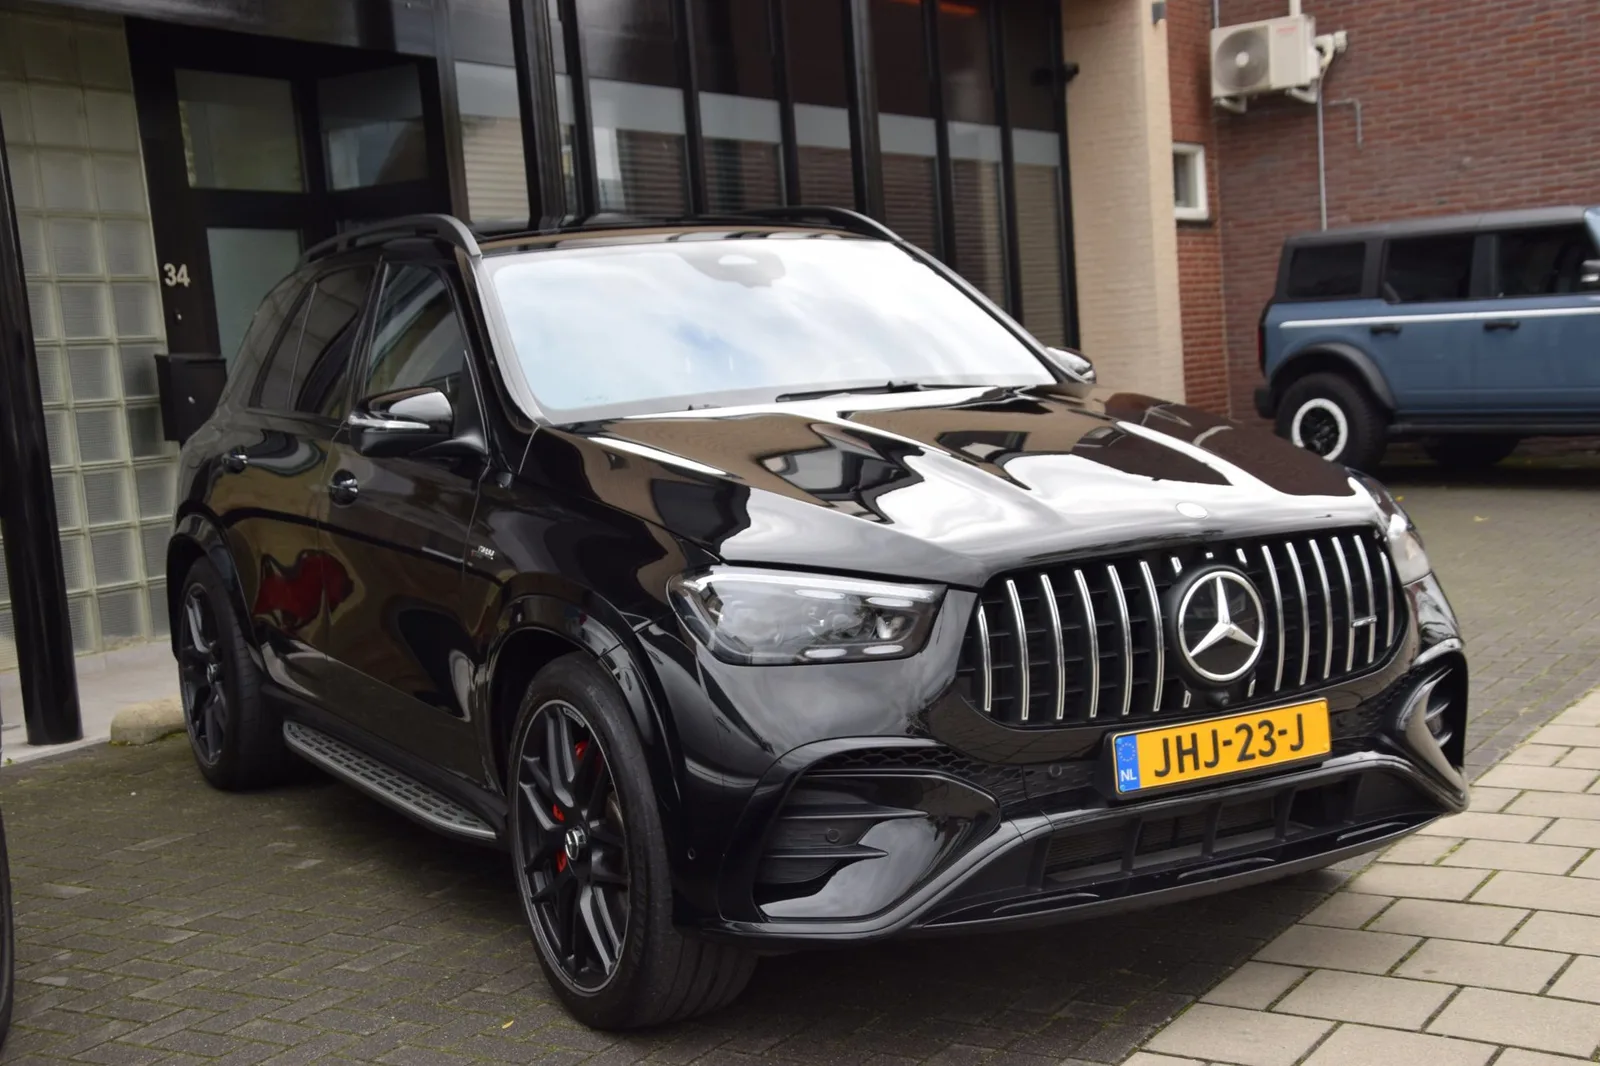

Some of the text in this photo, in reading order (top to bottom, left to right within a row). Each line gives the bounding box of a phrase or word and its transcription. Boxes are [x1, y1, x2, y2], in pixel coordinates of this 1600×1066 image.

[163, 262, 191, 287] 34
[1154, 713, 1305, 778] JHJ-23-J
[1120, 768, 1137, 782] NL
